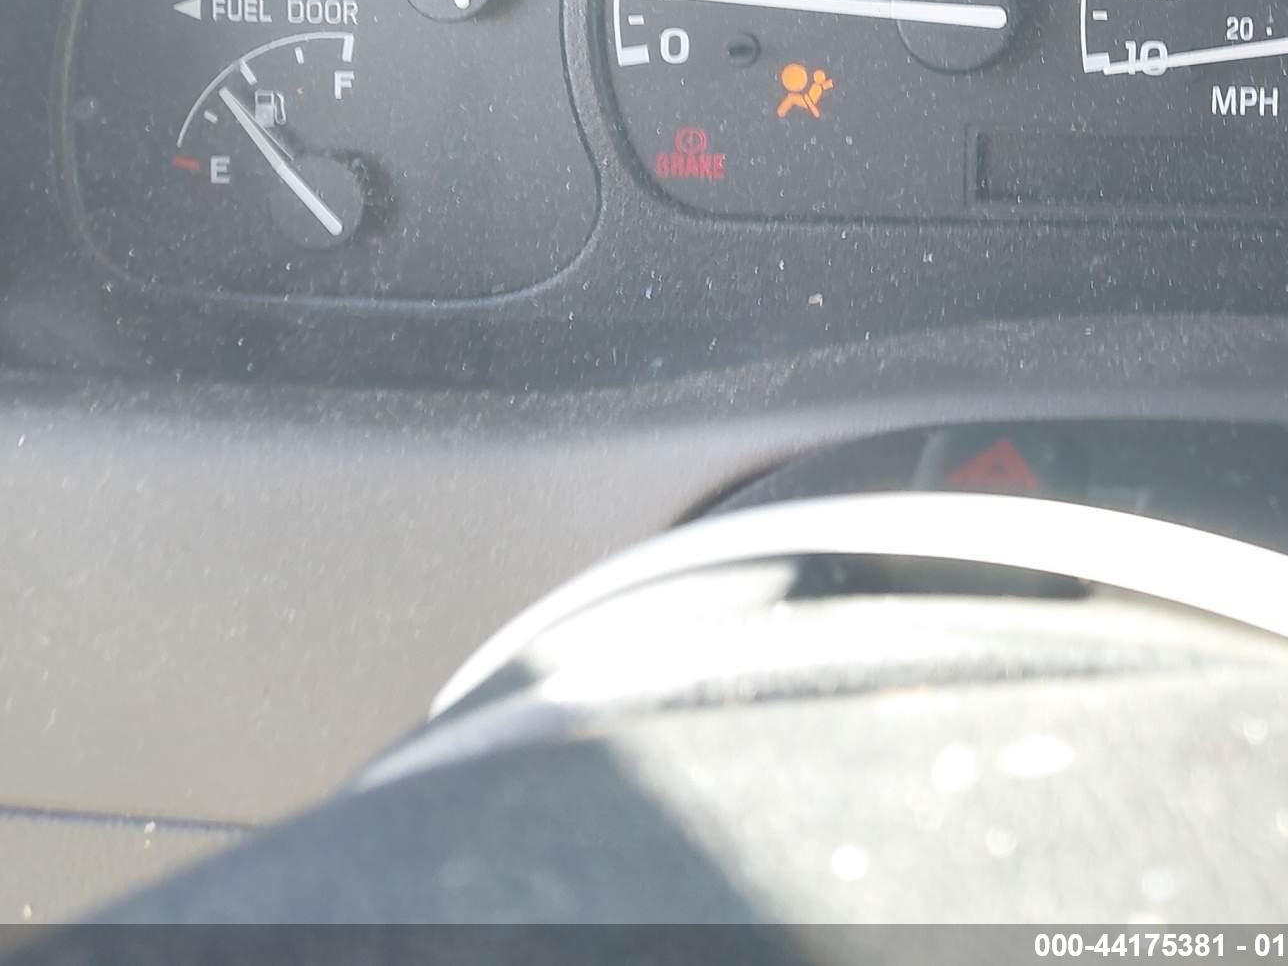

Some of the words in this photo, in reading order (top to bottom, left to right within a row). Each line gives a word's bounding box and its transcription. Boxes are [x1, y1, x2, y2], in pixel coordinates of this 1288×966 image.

[1226, 17, 1254, 40] 20
[660, 28, 690, 64] 0
[1125, 40, 1168, 75] 10
[334, 71, 355, 100] F
[1211, 86, 1279, 117] MPH
[210, 156, 231, 184] E
[656, 153, 726, 178] BRAKE
